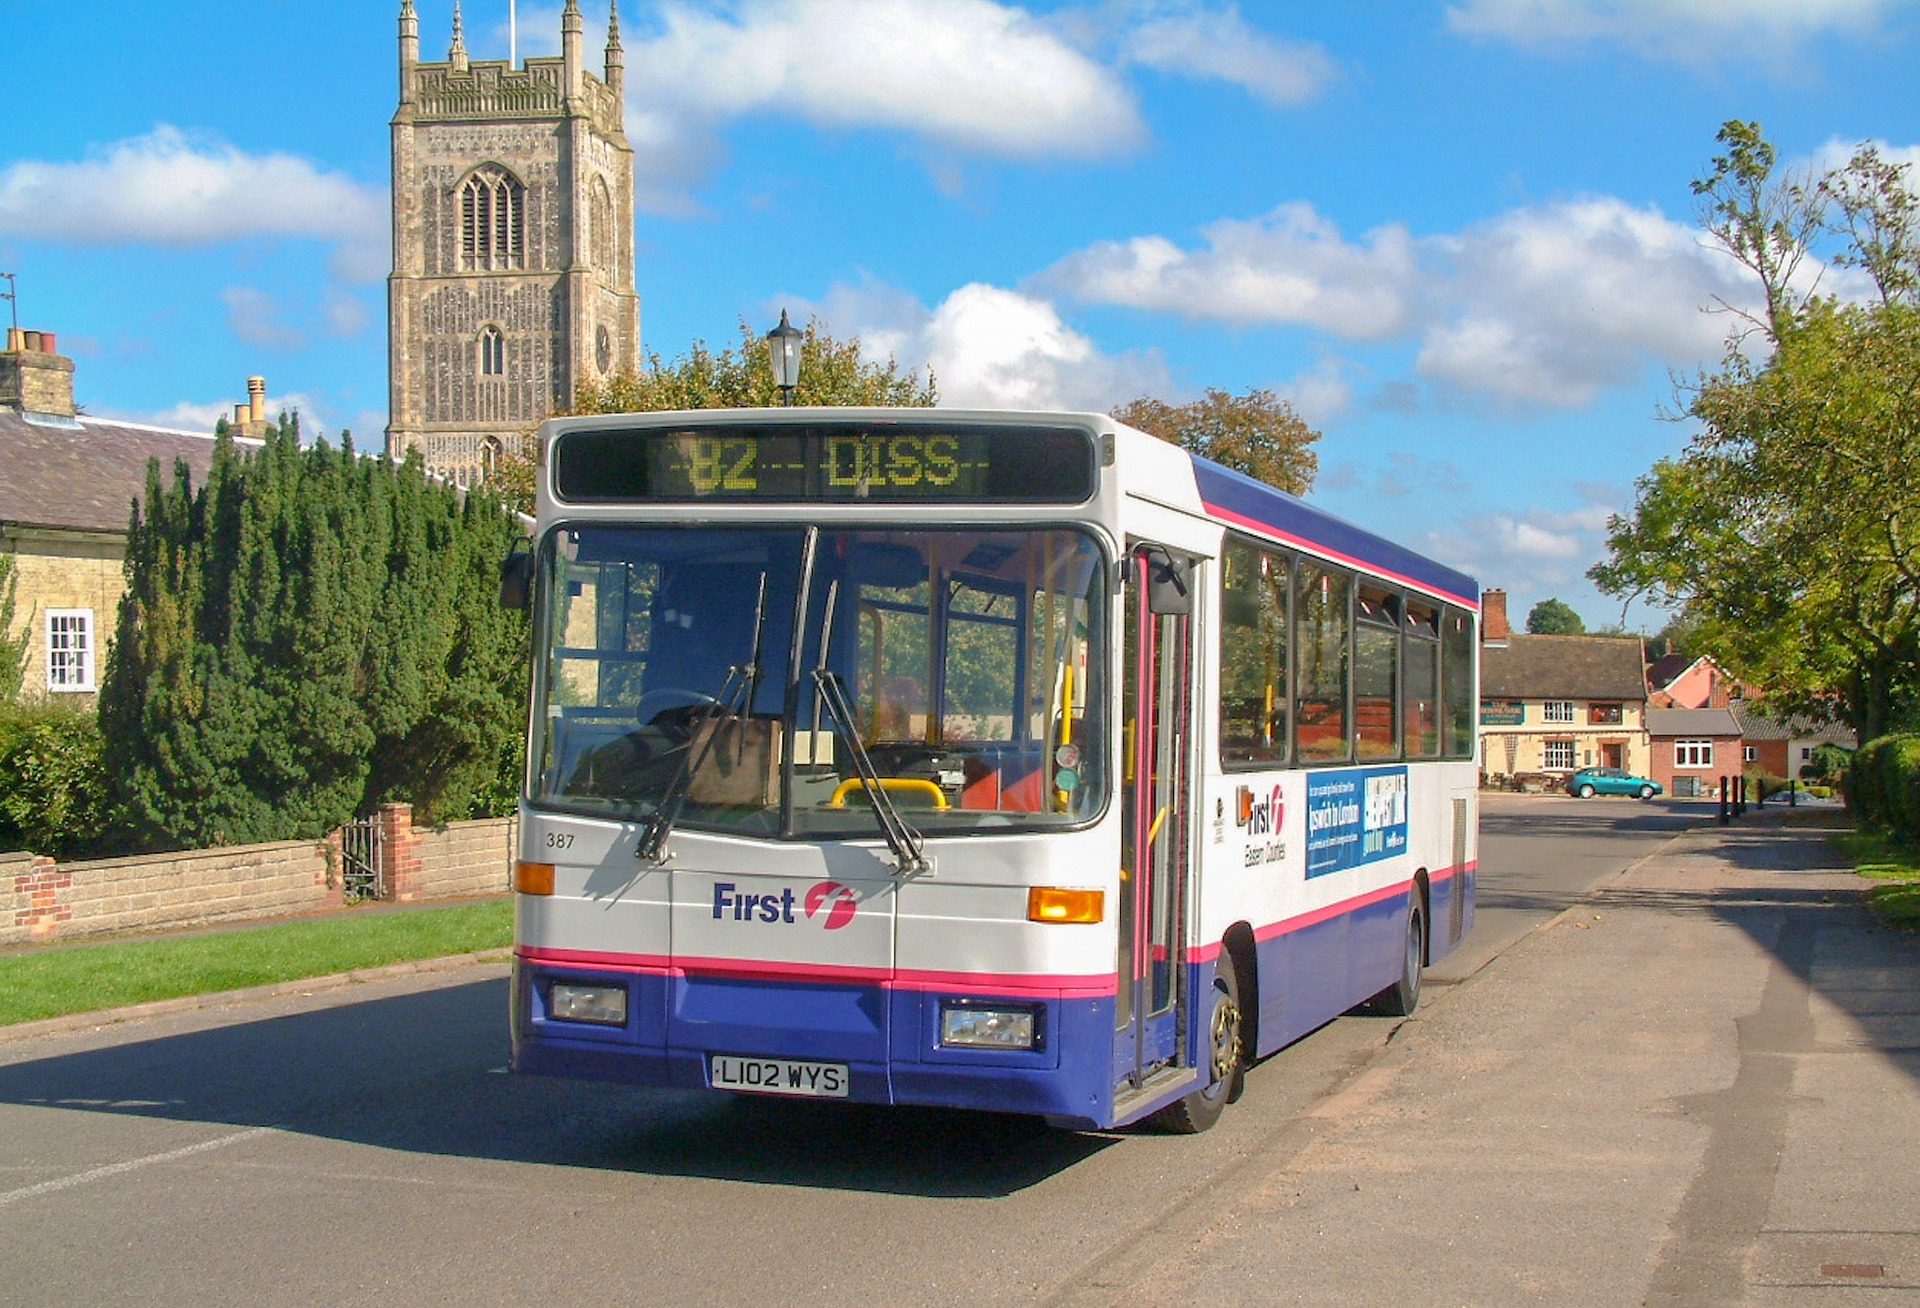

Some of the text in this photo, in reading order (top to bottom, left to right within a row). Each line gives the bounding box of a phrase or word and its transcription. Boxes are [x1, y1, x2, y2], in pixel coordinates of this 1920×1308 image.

[689, 435, 958, 490] 82 DISS
[546, 833, 575, 849] 387
[712, 882, 796, 924] First
[722, 1060, 840, 1091] L102 WYS
